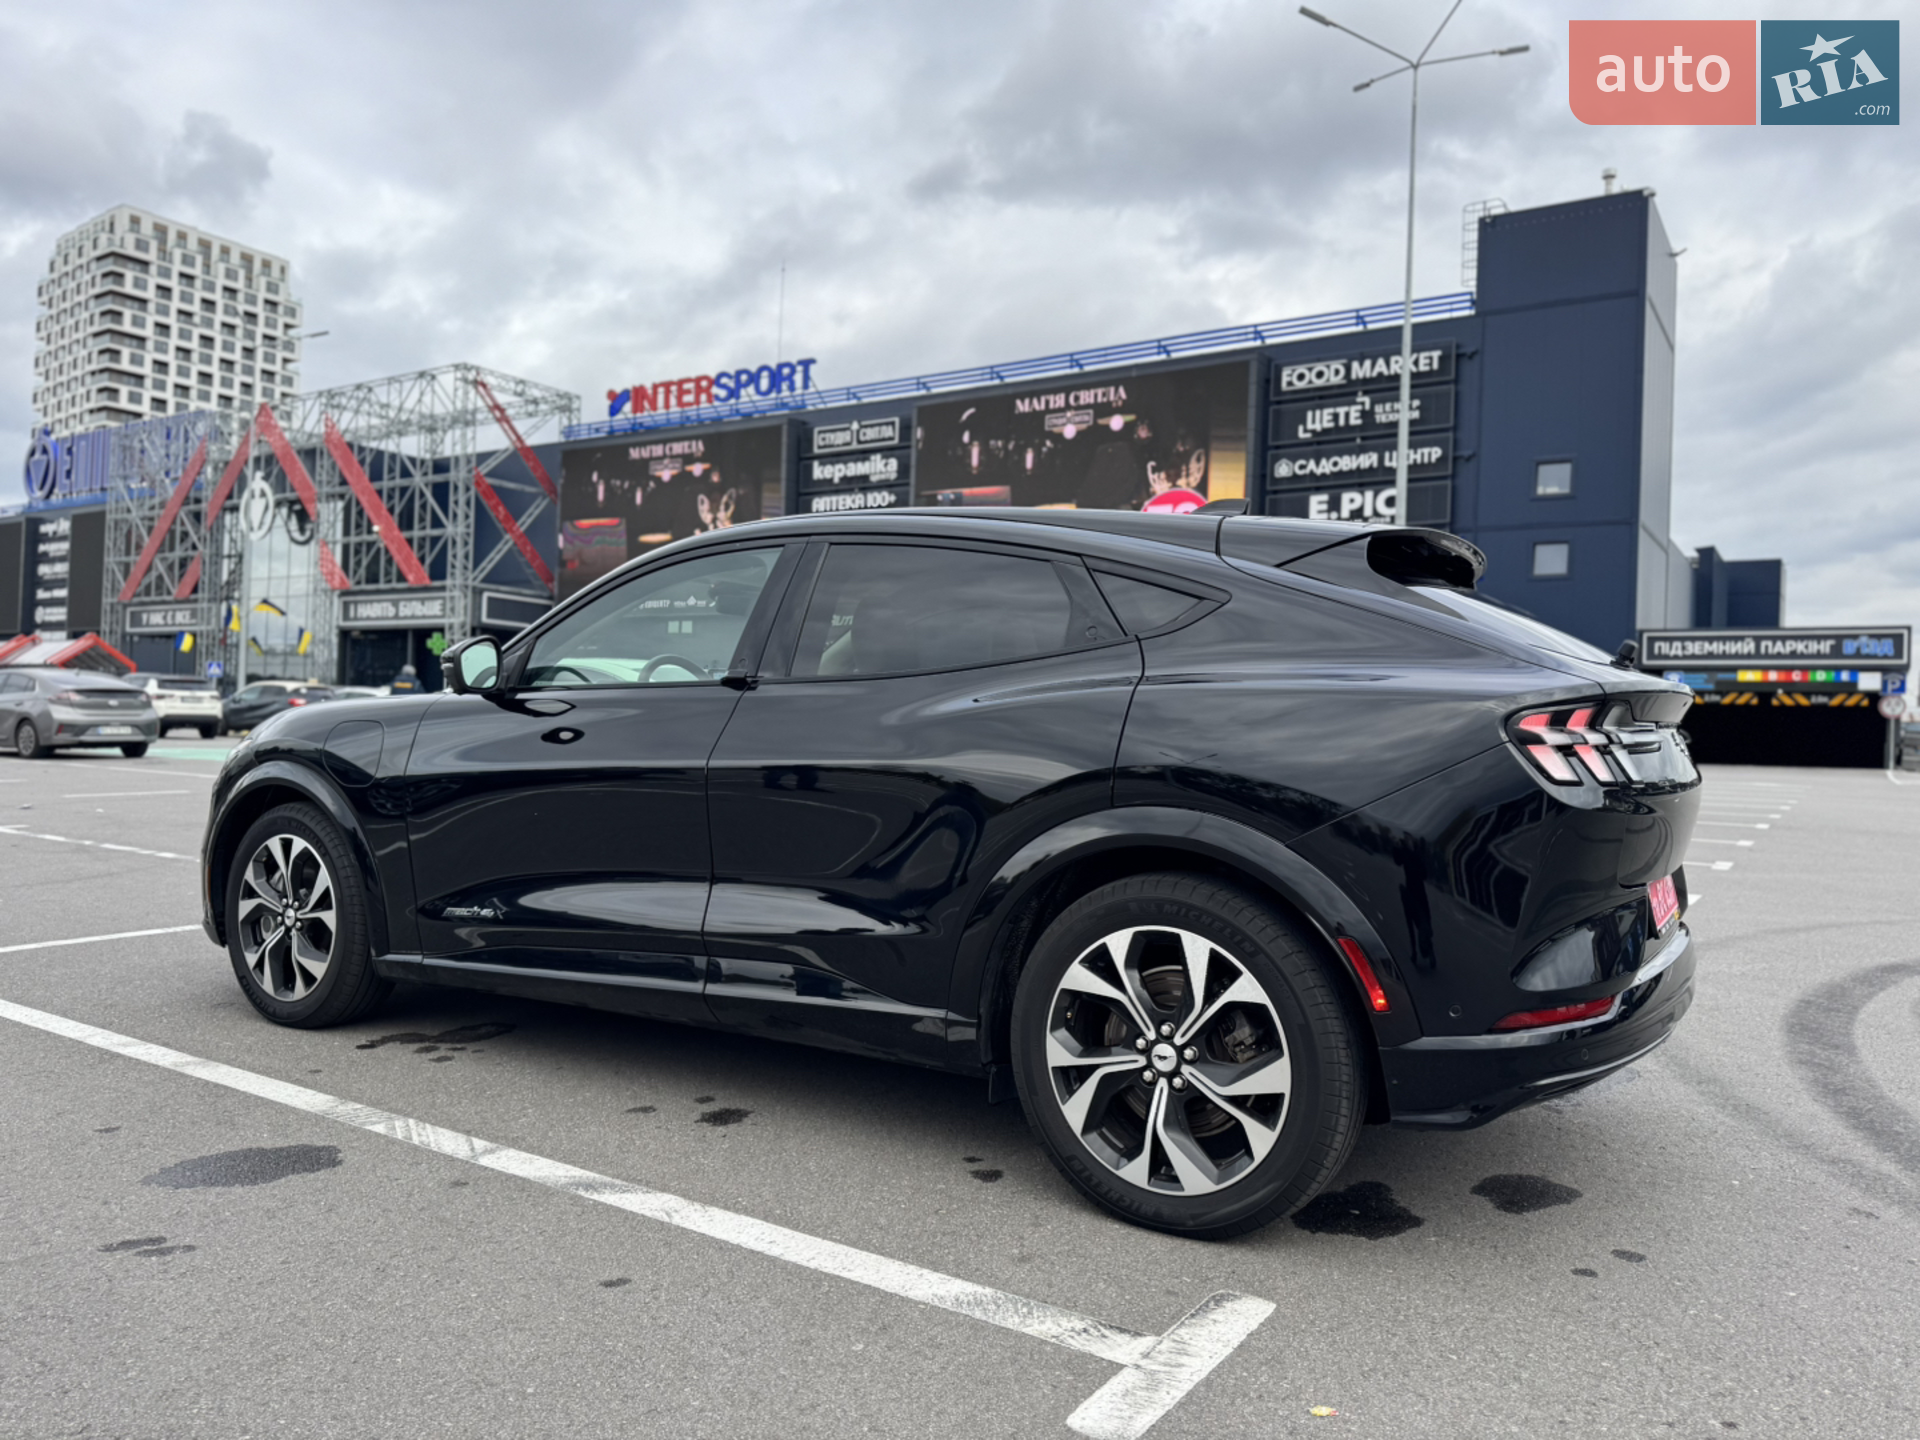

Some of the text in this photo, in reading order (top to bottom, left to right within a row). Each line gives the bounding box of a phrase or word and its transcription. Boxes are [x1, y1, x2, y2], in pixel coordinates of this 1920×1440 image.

[630, 358, 816, 414] INTERSPORT
[1281, 350, 1442, 391] FOOD MARKET
[1306, 404, 1363, 432] ЦЕТЕ
[1294, 446, 1442, 476] САДОВИЙ ЦНТР
[1654, 638, 1756, 657] ПІДЗЕМНИЙ
[1760, 639, 1836, 656] ПАРКІНГ
[1163, 903, 1256, 954] MICHELIN
